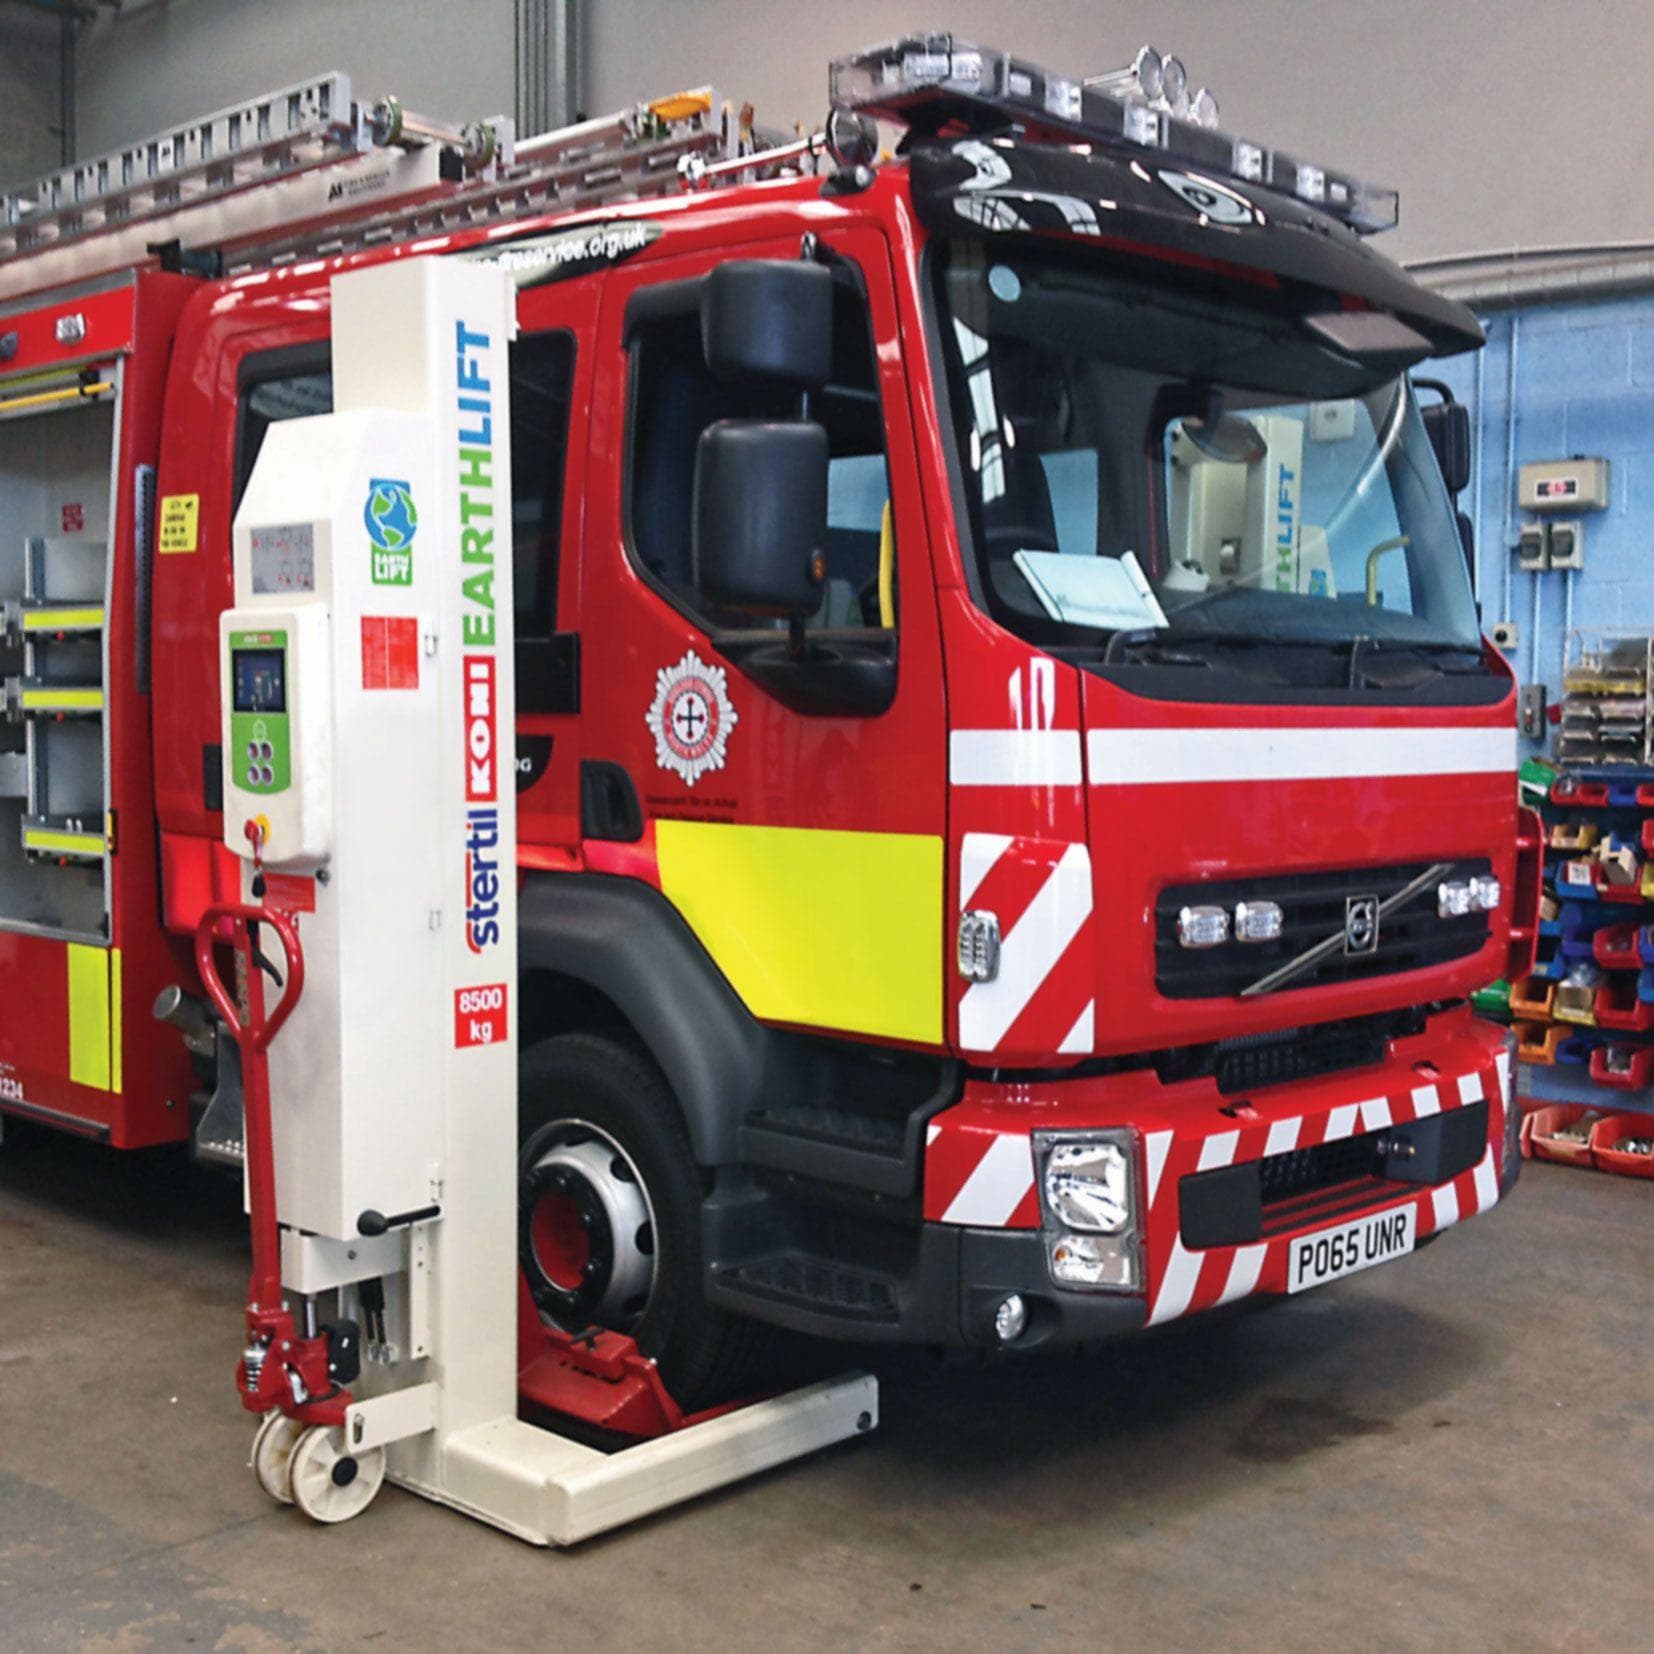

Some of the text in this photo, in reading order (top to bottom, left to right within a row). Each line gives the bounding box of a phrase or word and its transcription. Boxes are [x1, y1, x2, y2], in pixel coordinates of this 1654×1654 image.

[374, 562, 410, 580] LIFT
[456, 320, 500, 954] stertil KONI EARTHLIFT
[459, 988, 503, 1014] 8500
[470, 1018, 493, 1043] kg
[1298, 1213, 1407, 1284] PO65 UNR
